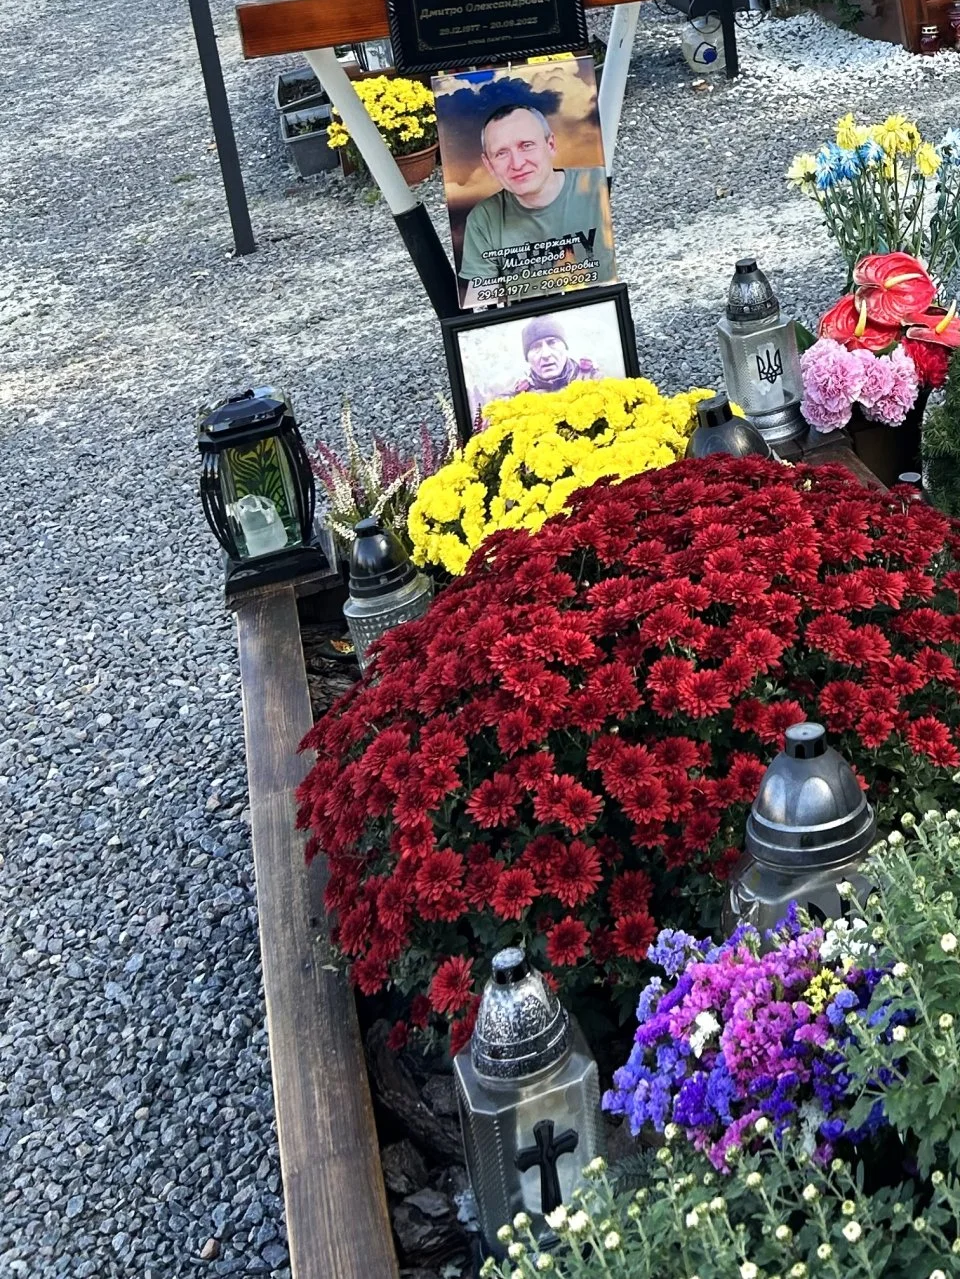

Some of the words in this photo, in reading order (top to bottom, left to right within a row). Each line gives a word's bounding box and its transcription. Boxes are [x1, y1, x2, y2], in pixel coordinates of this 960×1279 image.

[420, 5, 463, 20] Дмитро
[482, 243, 531, 259] старший
[534, 236, 581, 251] сержант
[502, 250, 565, 270] Мілосердов
[472, 274, 519, 288] Дмитро
[521, 260, 600, 278] Олександрович
[477, 284, 529, 301] 29.12.1977
[540, 272, 598, 290] 20.09.2023
